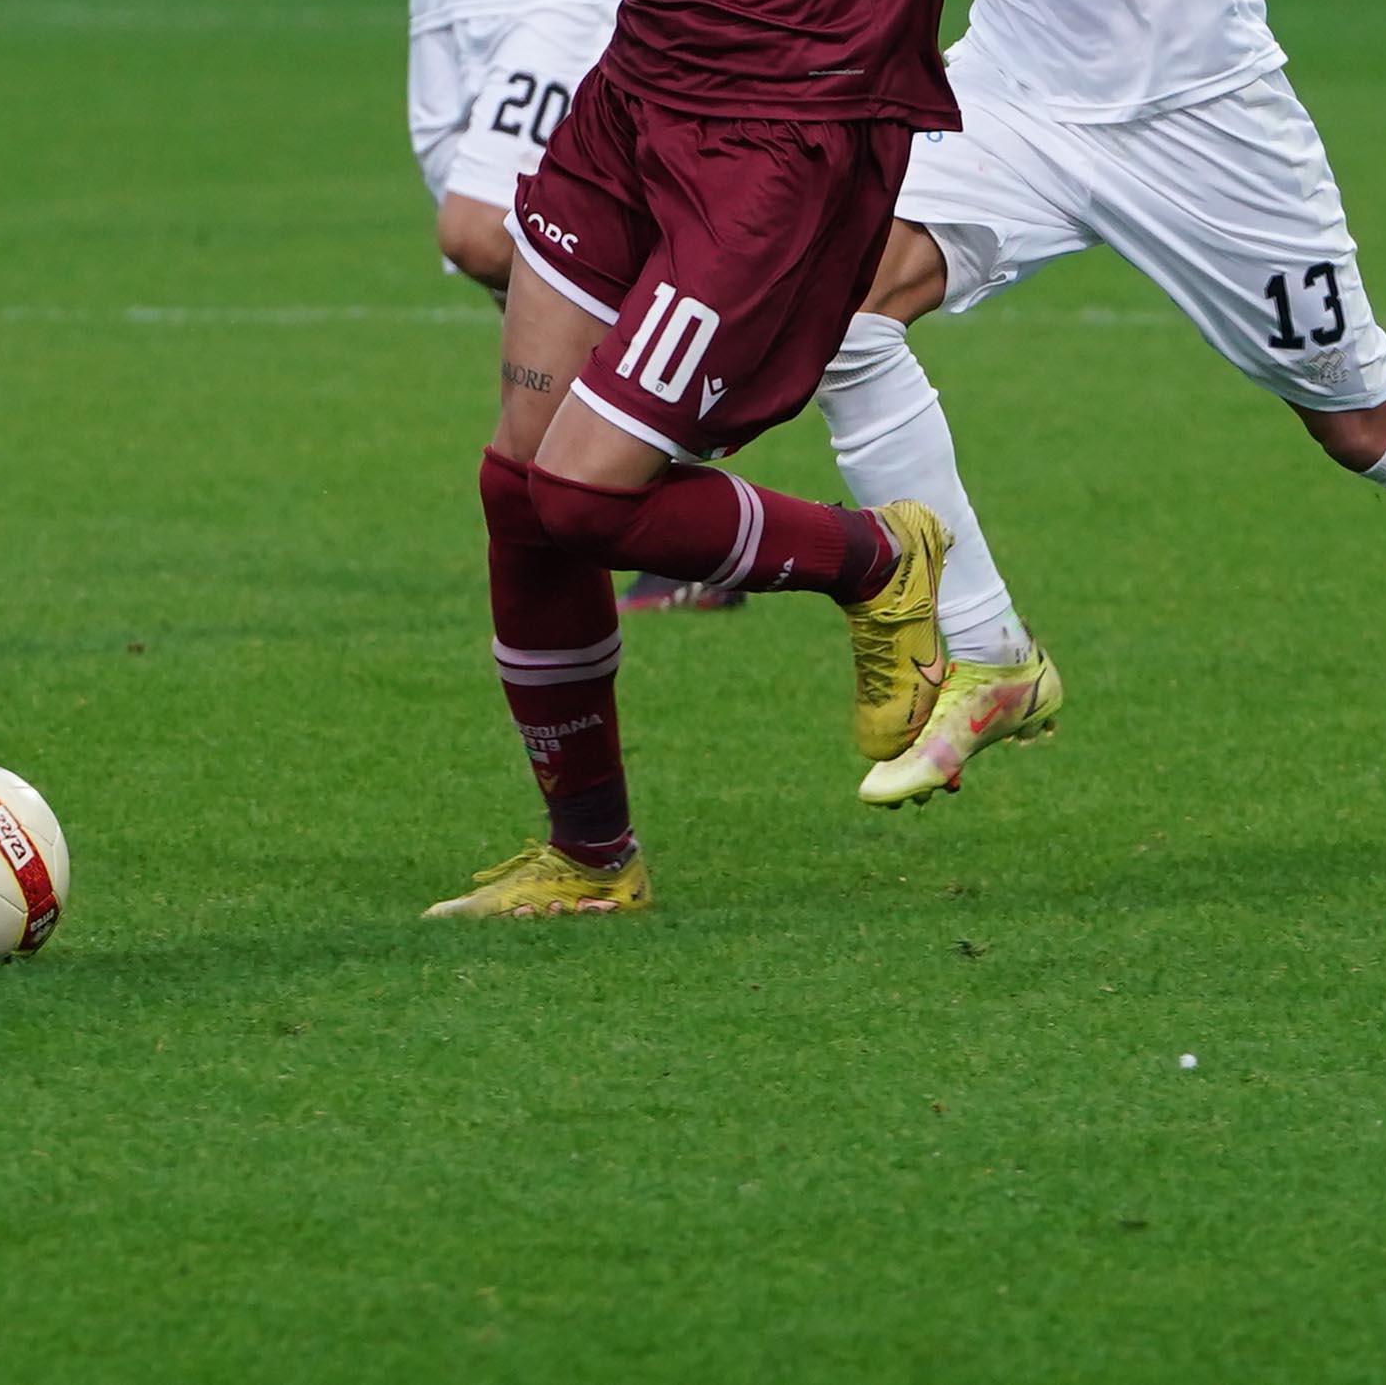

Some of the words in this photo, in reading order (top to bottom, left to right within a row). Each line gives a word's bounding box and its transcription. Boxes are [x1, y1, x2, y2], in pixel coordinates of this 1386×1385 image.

[491, 72, 570, 147] 20
[615, 281, 721, 404] 10
[1265, 261, 1347, 350] 13
